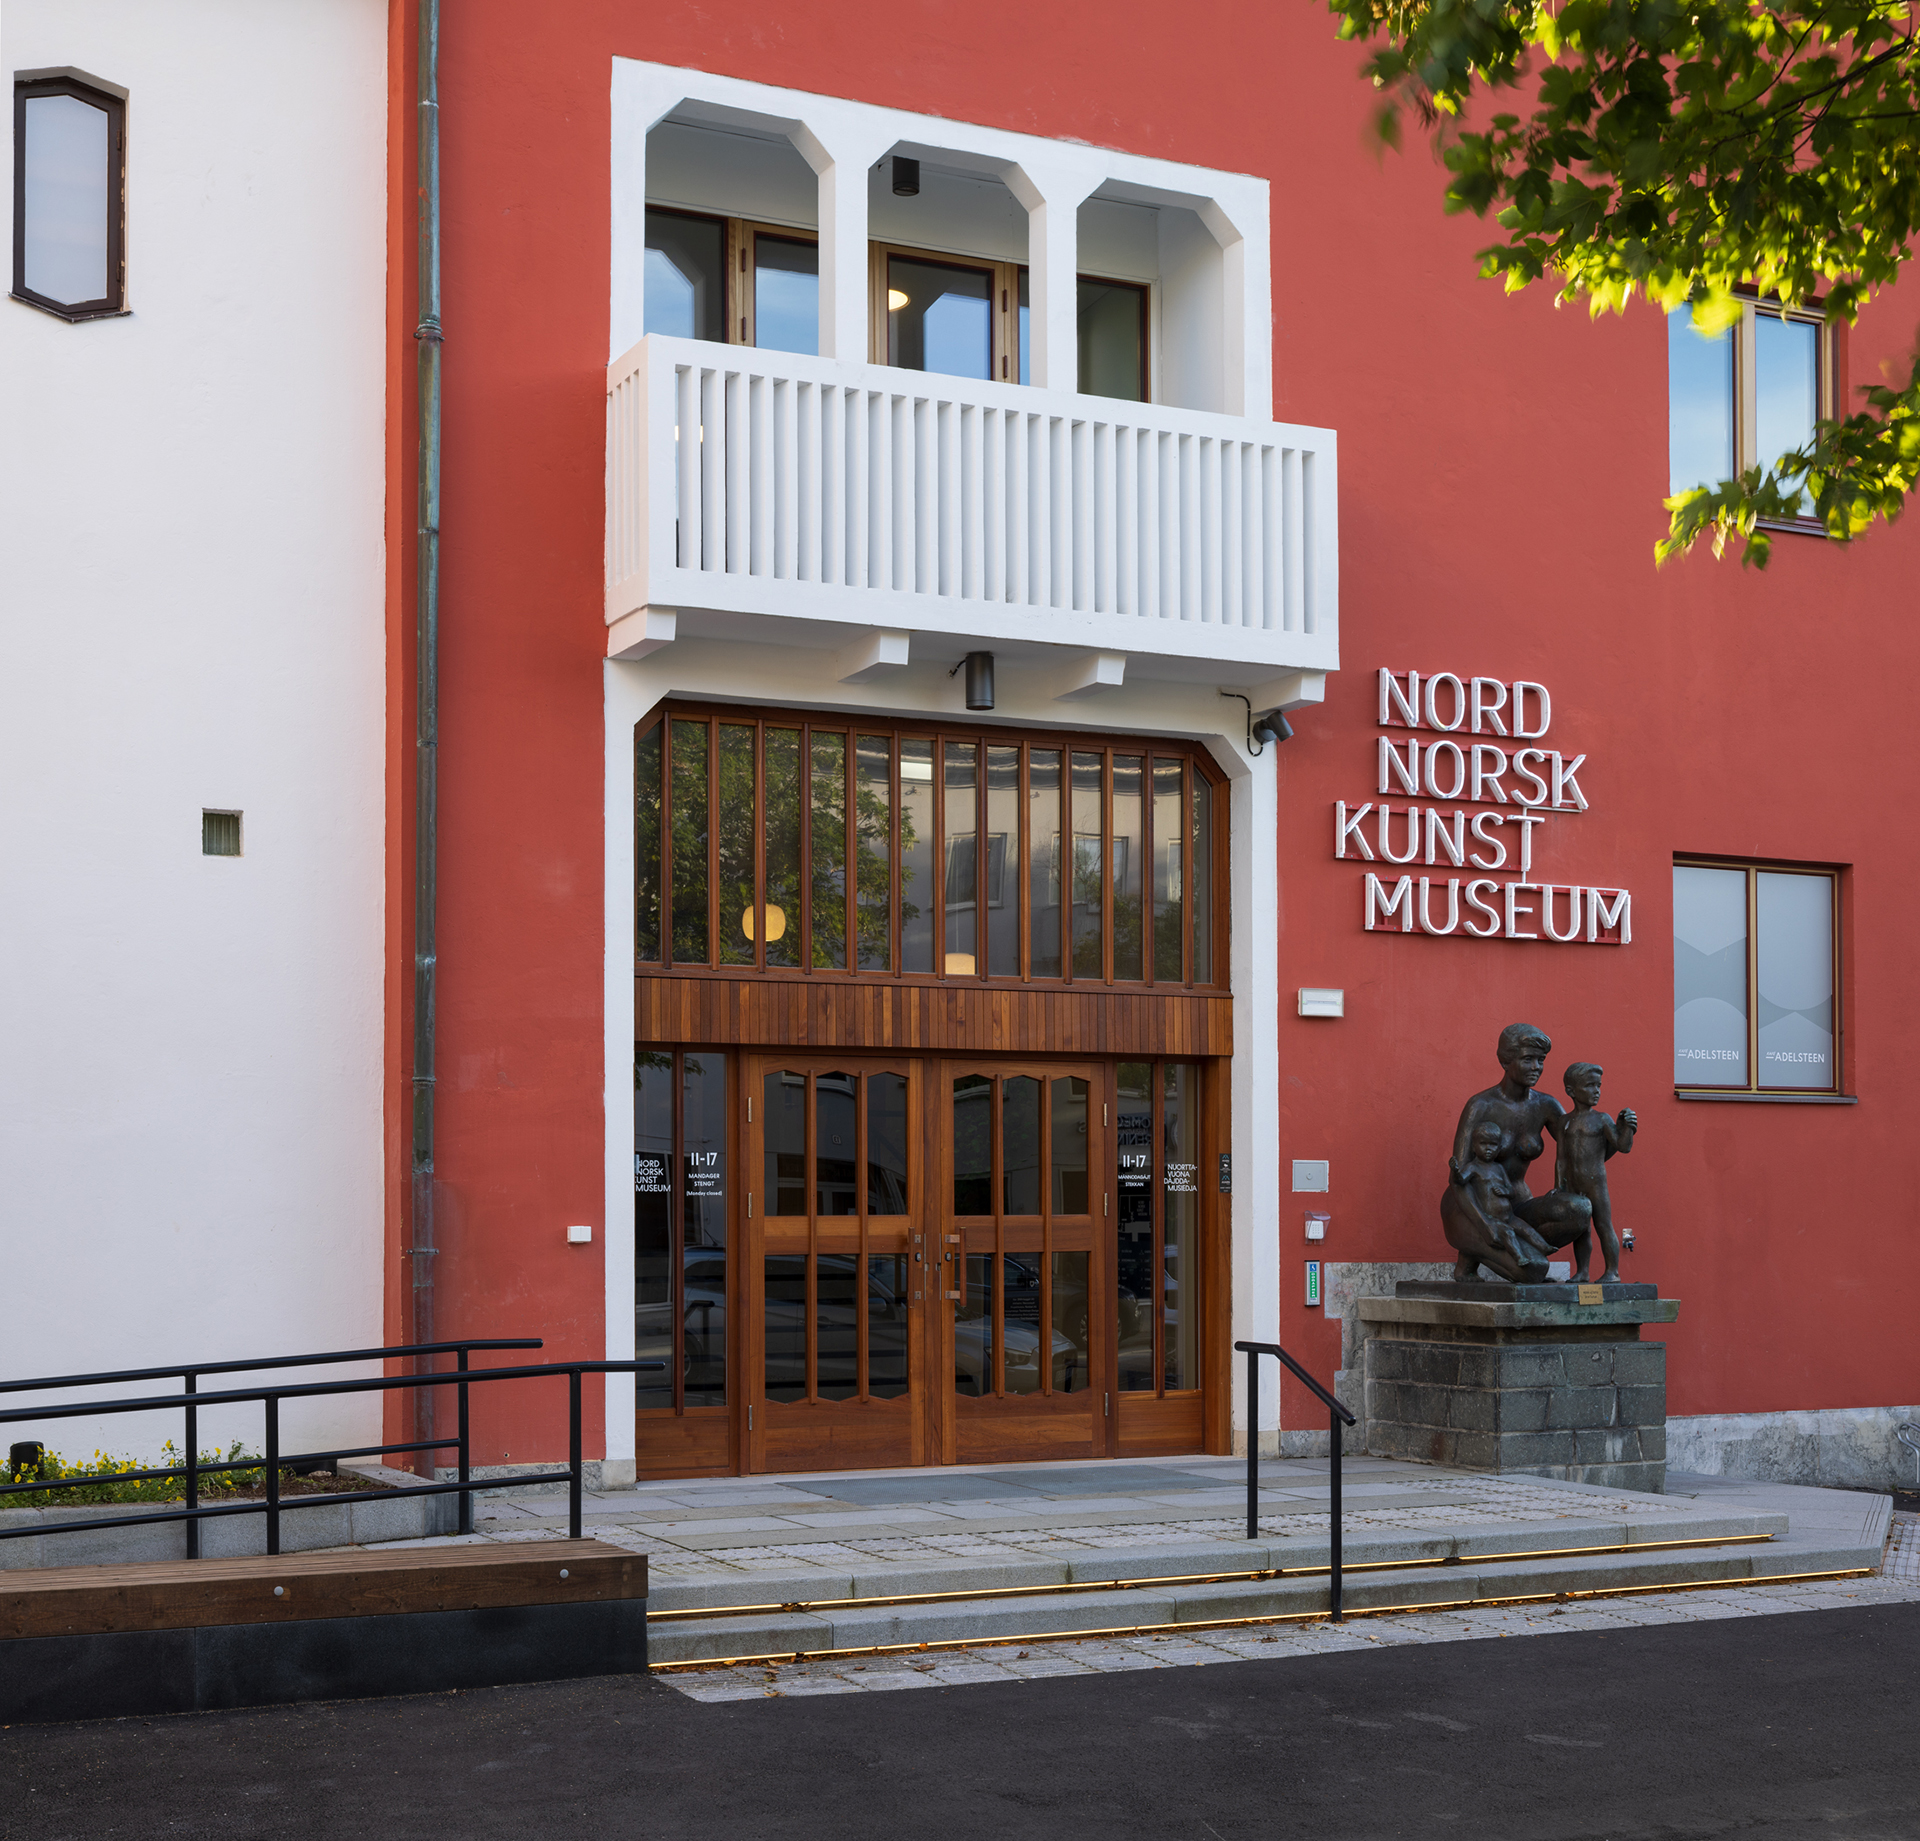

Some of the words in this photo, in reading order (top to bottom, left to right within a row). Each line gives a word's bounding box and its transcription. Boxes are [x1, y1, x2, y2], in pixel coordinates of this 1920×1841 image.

[1378, 667, 1551, 739] NORD
[1378, 736, 1589, 810] NORSK
[1335, 800, 1545, 872] KUNST
[1365, 873, 1632, 944] MUSEUM
[1687, 1049, 1739, 1060] ADELSTEEN
[1774, 1051, 1825, 1063] ADELSTEEN
[691, 1152, 718, 1166] 11-17
[1122, 1155, 1147, 1168] 11-17
[636, 1168, 664, 1176] NORSK
[635, 1184, 671, 1192] MUSEUM
